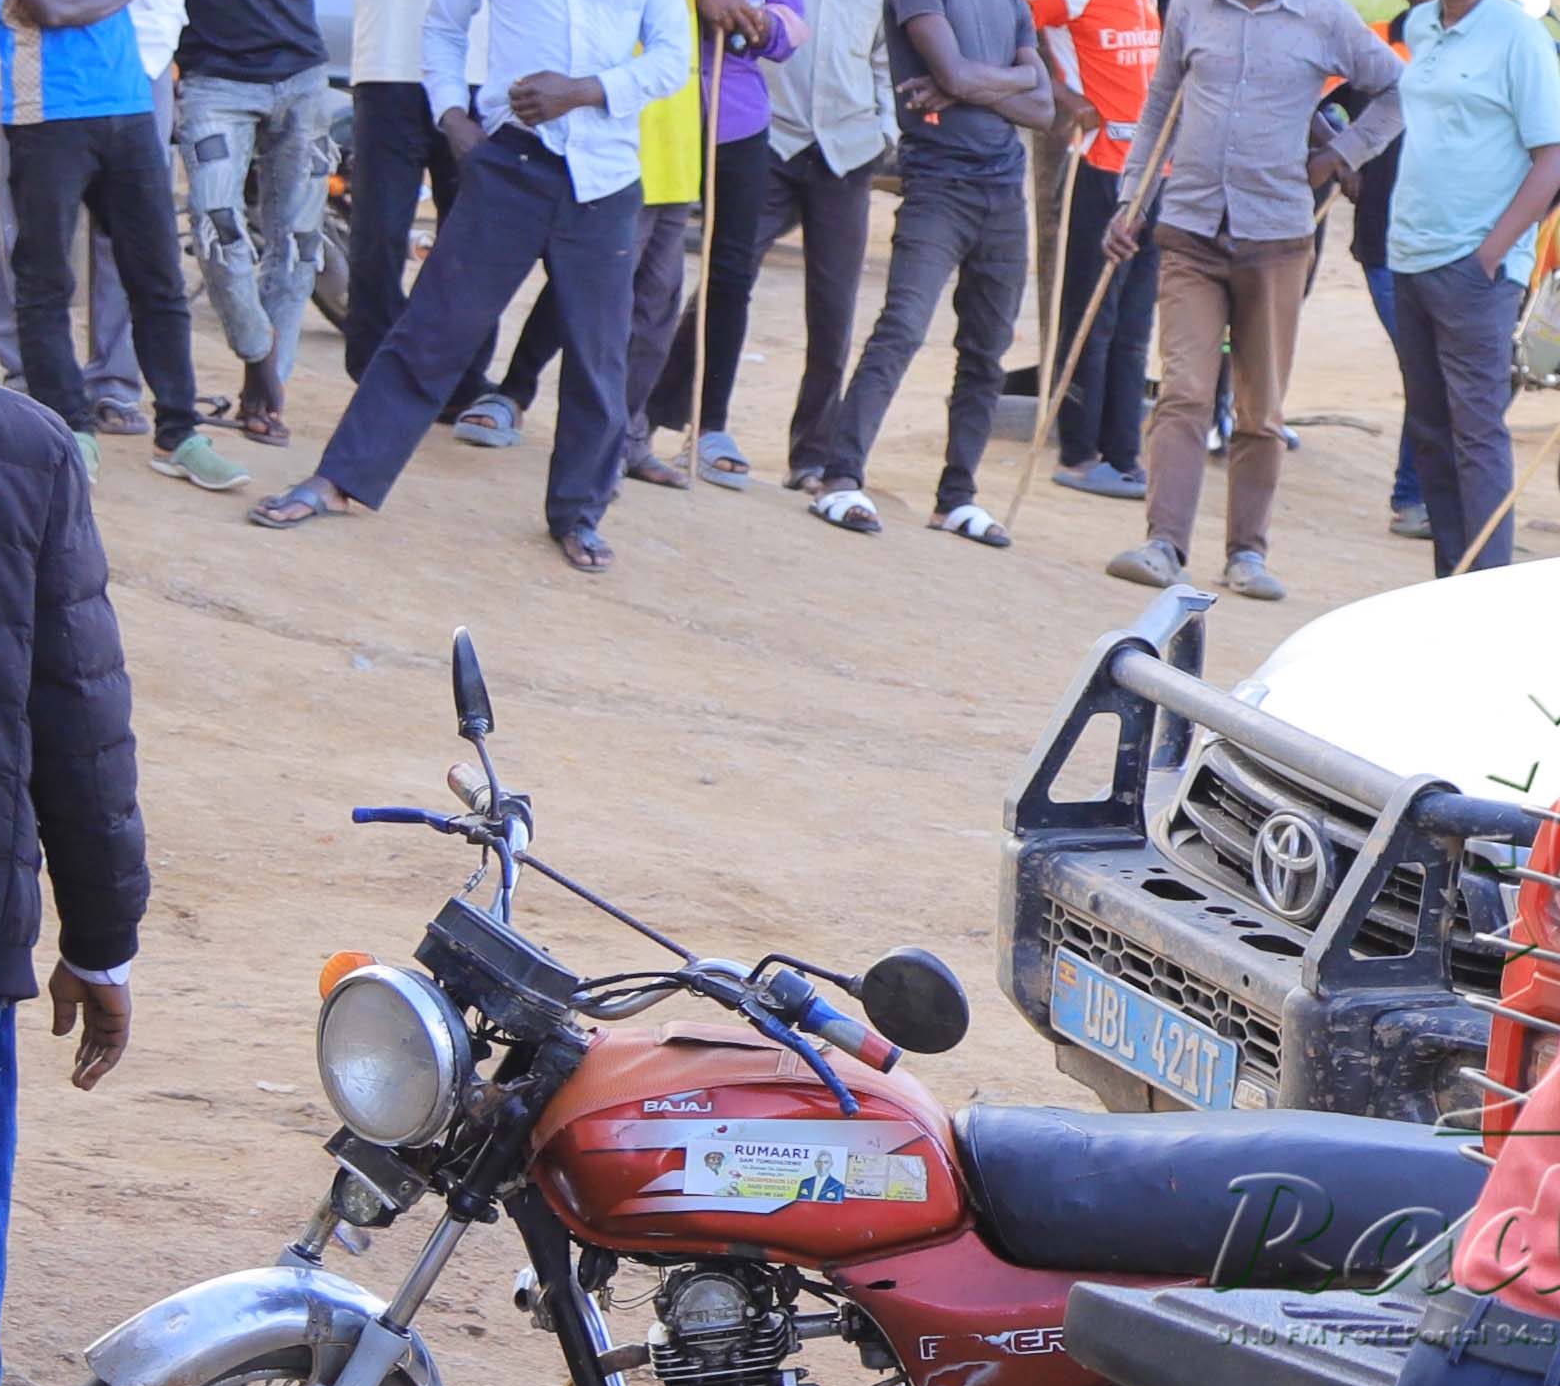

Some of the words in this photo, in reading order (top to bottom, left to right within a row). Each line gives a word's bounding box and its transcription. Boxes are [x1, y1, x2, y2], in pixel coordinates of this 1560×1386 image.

[1082, 975, 1136, 1061] UBL
[1150, 1019, 1220, 1107] 421T
[643, 1100, 712, 1112] BAJAJ
[735, 1144, 810, 1159] RUMAARI
